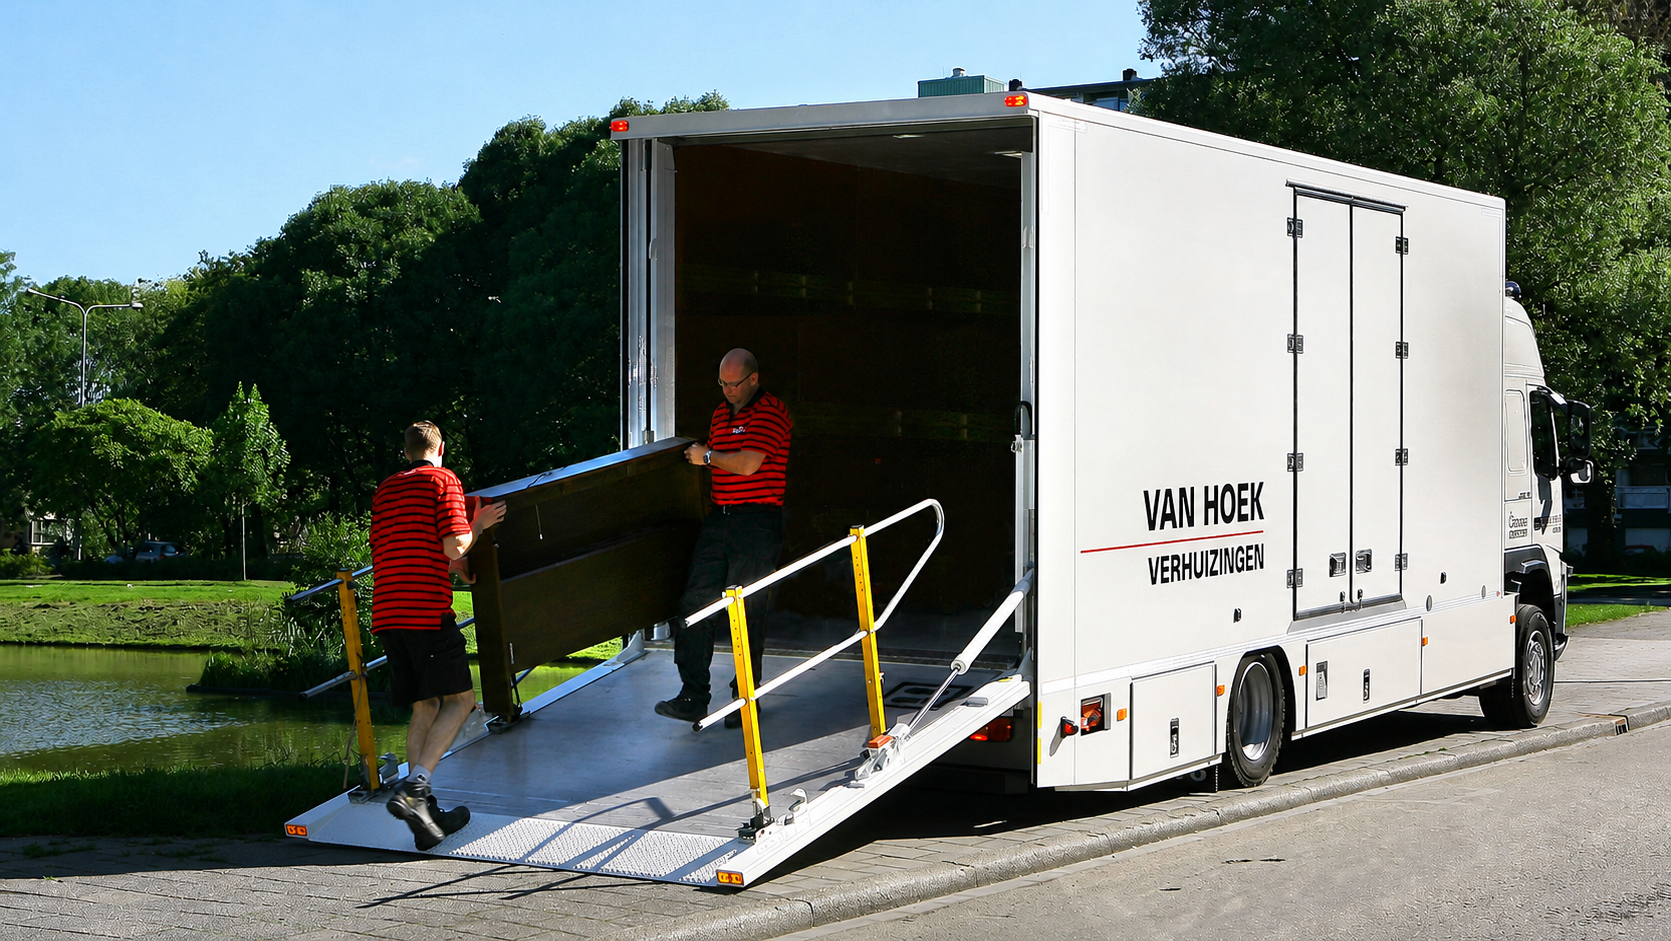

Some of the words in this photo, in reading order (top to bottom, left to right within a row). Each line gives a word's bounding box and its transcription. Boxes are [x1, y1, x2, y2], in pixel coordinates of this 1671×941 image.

[1143, 486, 1195, 531] VAN
[1203, 481, 1265, 526] HOEK
[1147, 543, 1264, 585] VERHUIZINGEN
